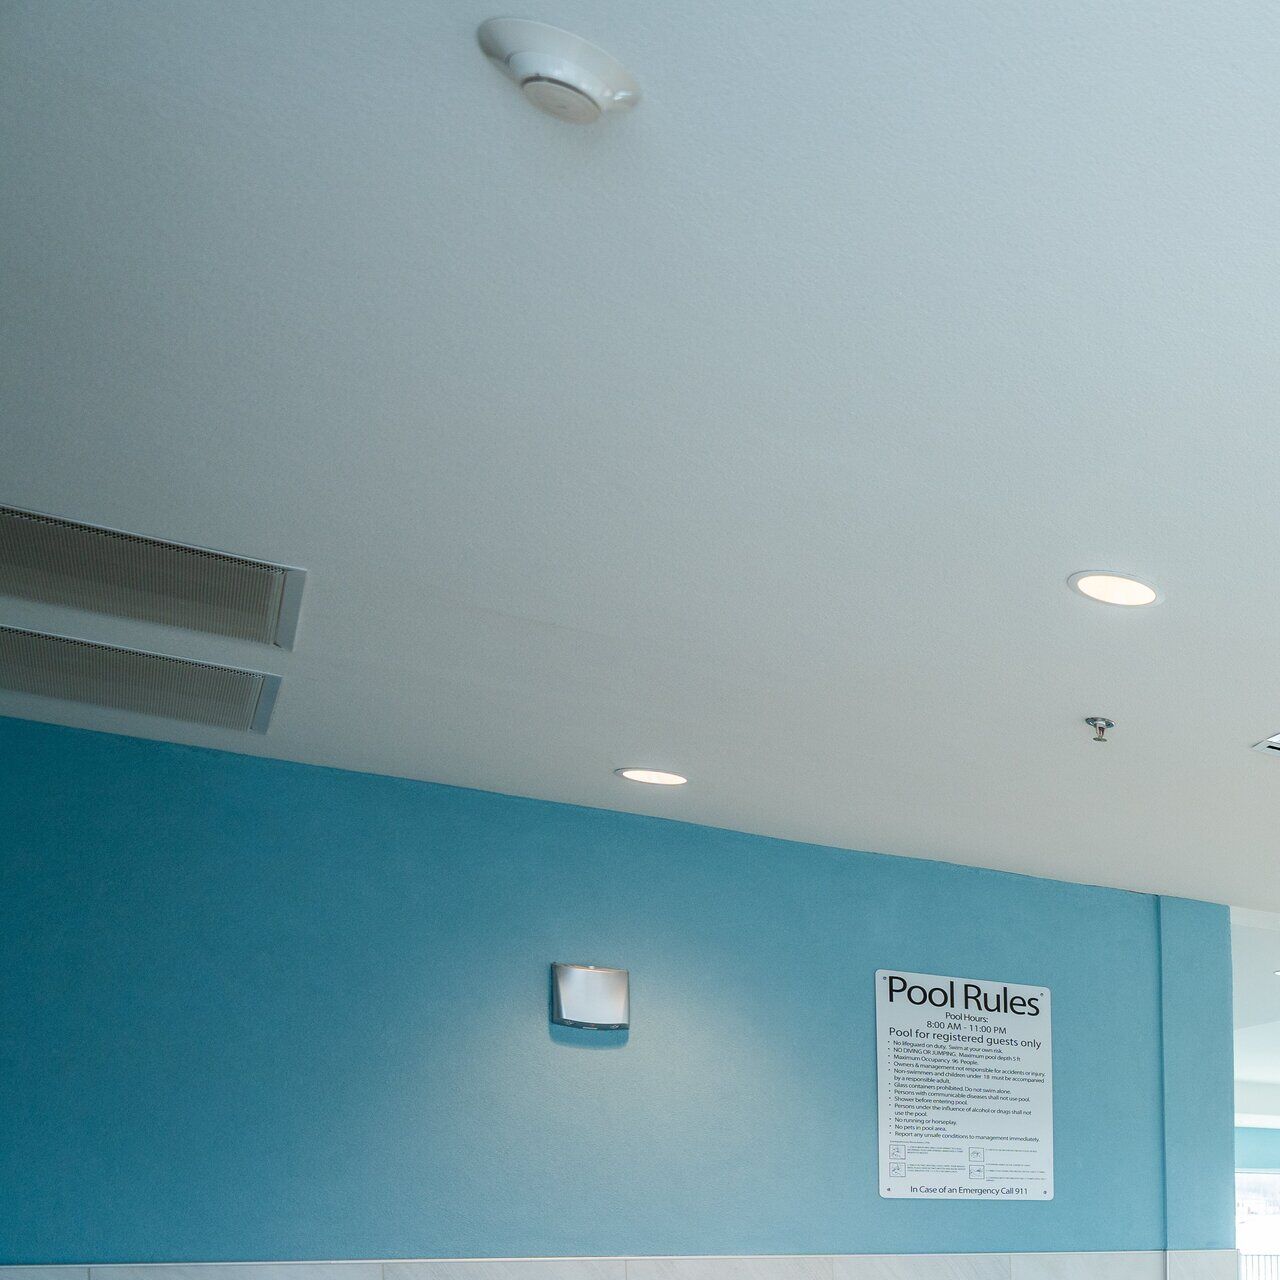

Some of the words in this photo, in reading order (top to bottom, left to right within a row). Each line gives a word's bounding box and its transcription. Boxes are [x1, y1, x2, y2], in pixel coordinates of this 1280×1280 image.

[889, 976, 954, 1008] Pool
[965, 984, 1040, 1016] Rules
[946, 1012, 962, 1020] Pool
[964, 1014, 988, 1023] Hours:
[927, 1021, 945, 1029] 8:00
[947, 1022, 962, 1030] AM
[970, 1025, 991, 1033] 11:00
[889, 1027, 912, 1037] Pool
[915, 1029, 930, 1039] for
[933, 1032, 984, 1043] registered
[987, 1037, 1018, 1047] guests
[1021, 1039, 1041, 1050] only
[959, 1187, 1000, 1195] Emergency
